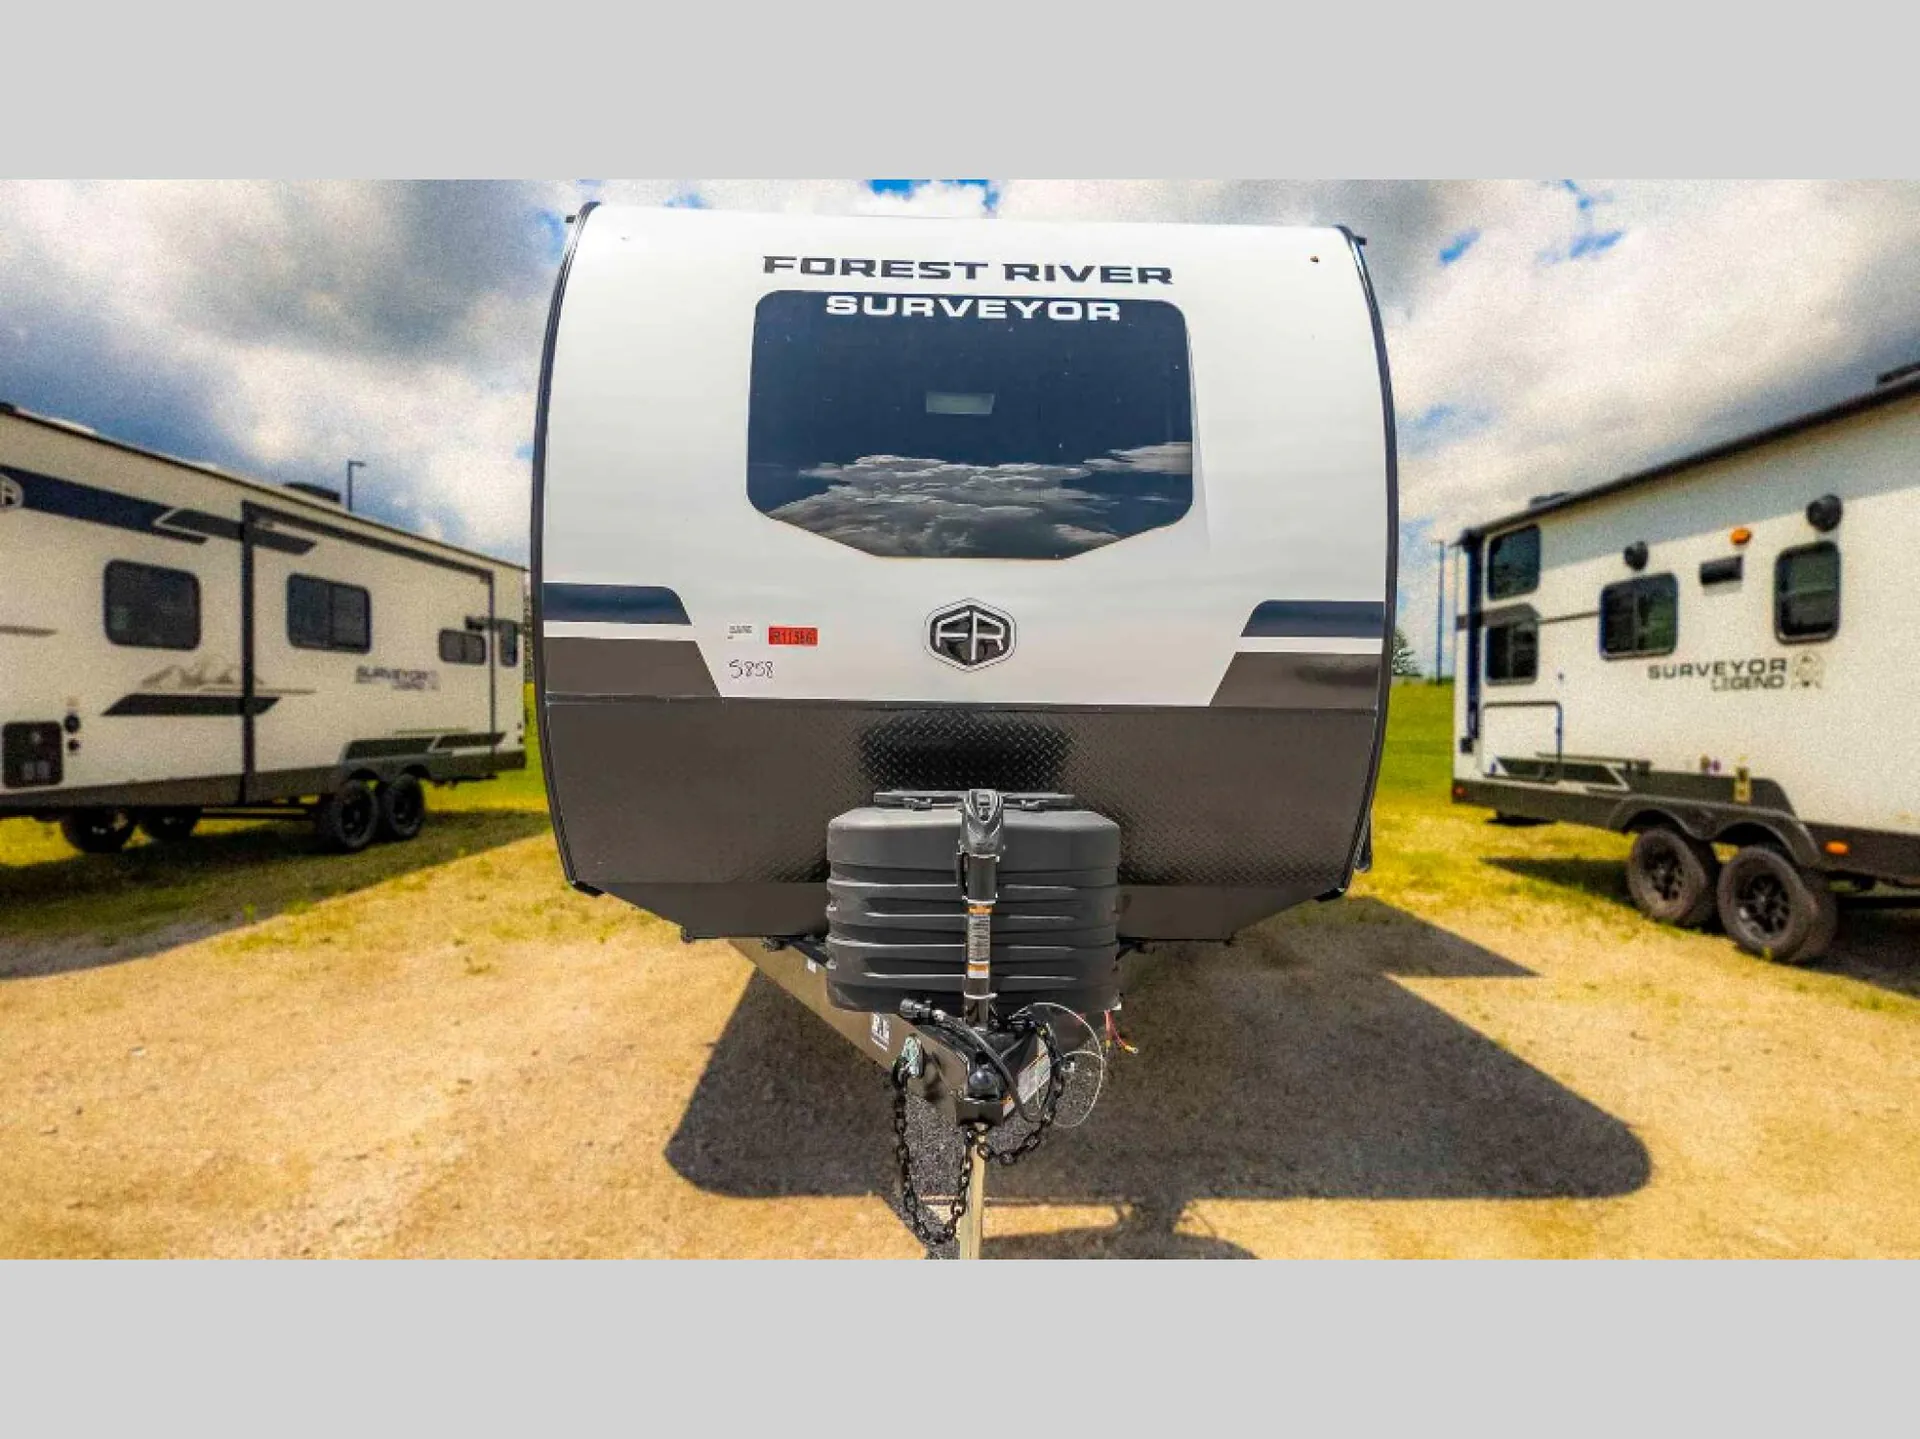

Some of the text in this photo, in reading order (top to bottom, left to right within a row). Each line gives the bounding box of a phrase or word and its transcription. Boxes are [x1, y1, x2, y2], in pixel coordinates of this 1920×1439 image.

[762, 255, 1175, 285] FOREST RIVER
[825, 294, 1121, 321] SURVEYOR
[728, 659, 774, 679] 5858
[1647, 657, 1787, 680] SURVEYOR
[1710, 674, 1785, 692] LEGEND
